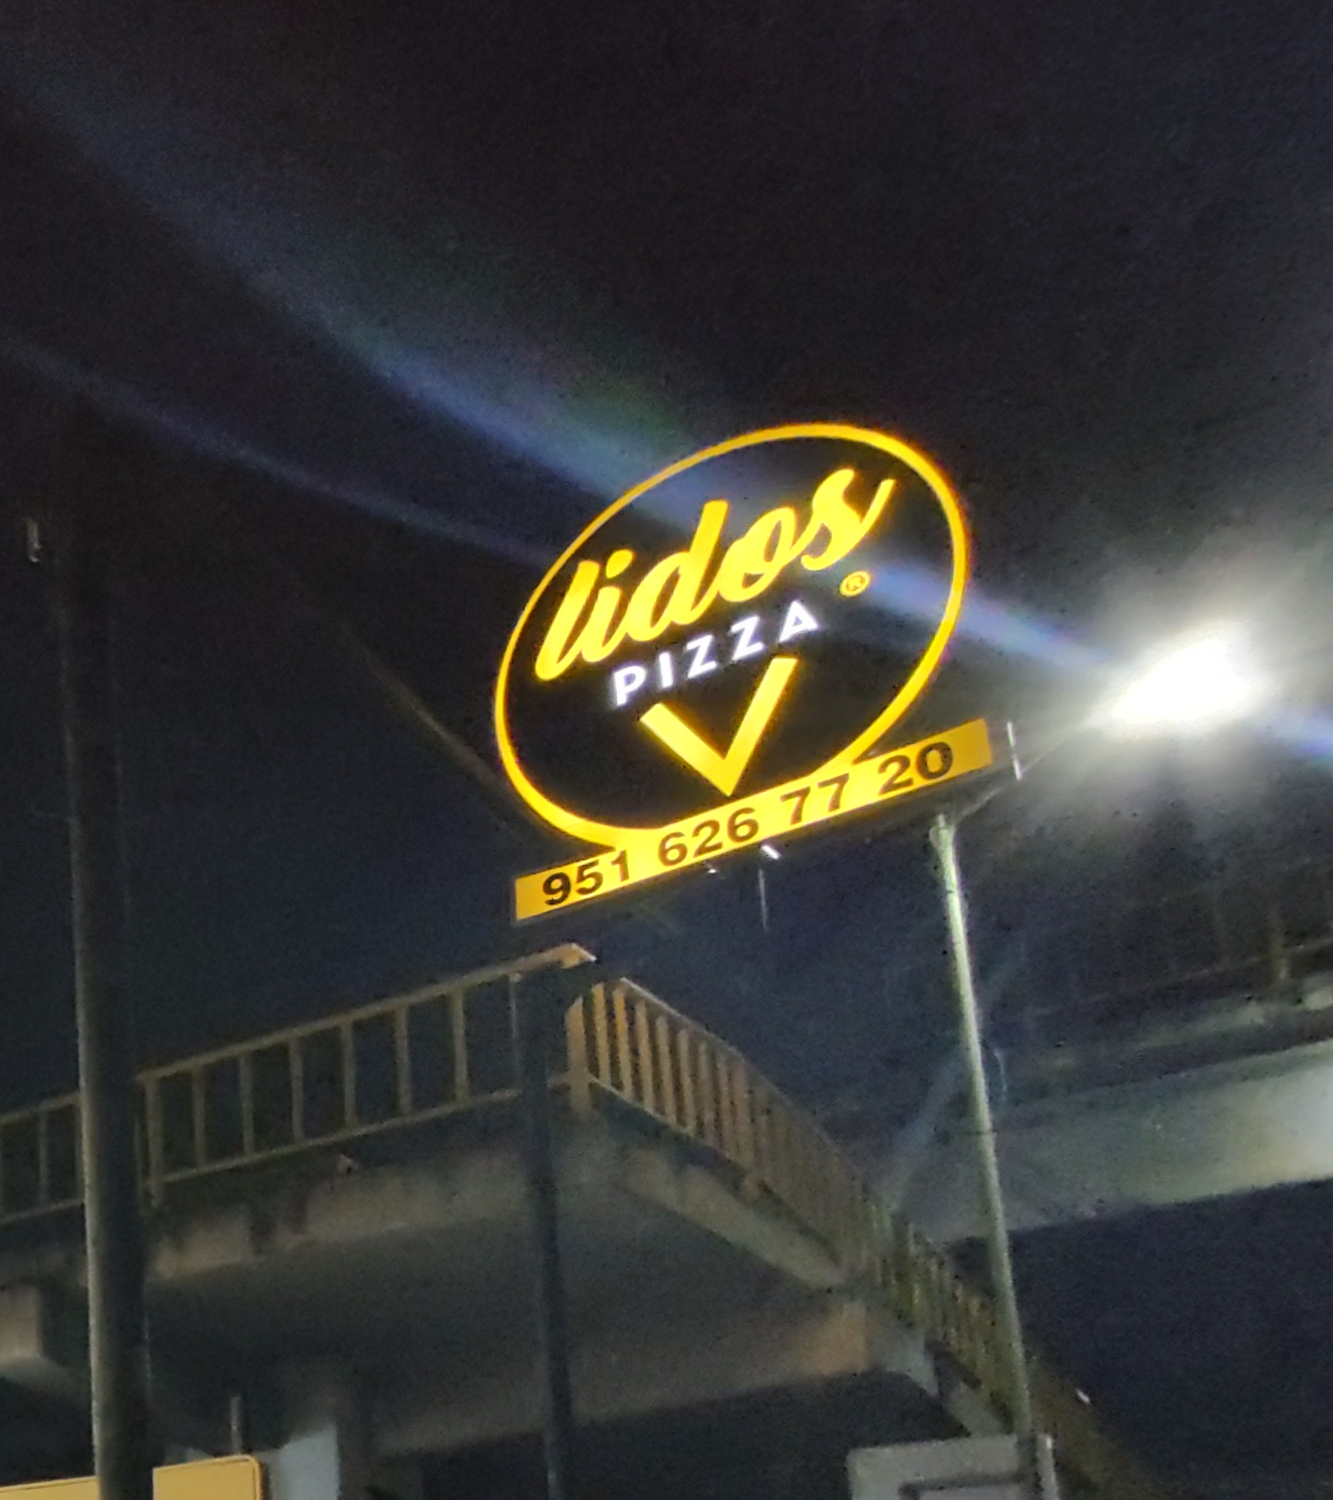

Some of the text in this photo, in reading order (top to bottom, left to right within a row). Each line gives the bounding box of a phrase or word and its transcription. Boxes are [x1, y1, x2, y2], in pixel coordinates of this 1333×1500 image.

[535, 467, 897, 682] lidos
[611, 599, 821, 706] PIZZA
[542, 741, 954, 906] 951 626 77 20
